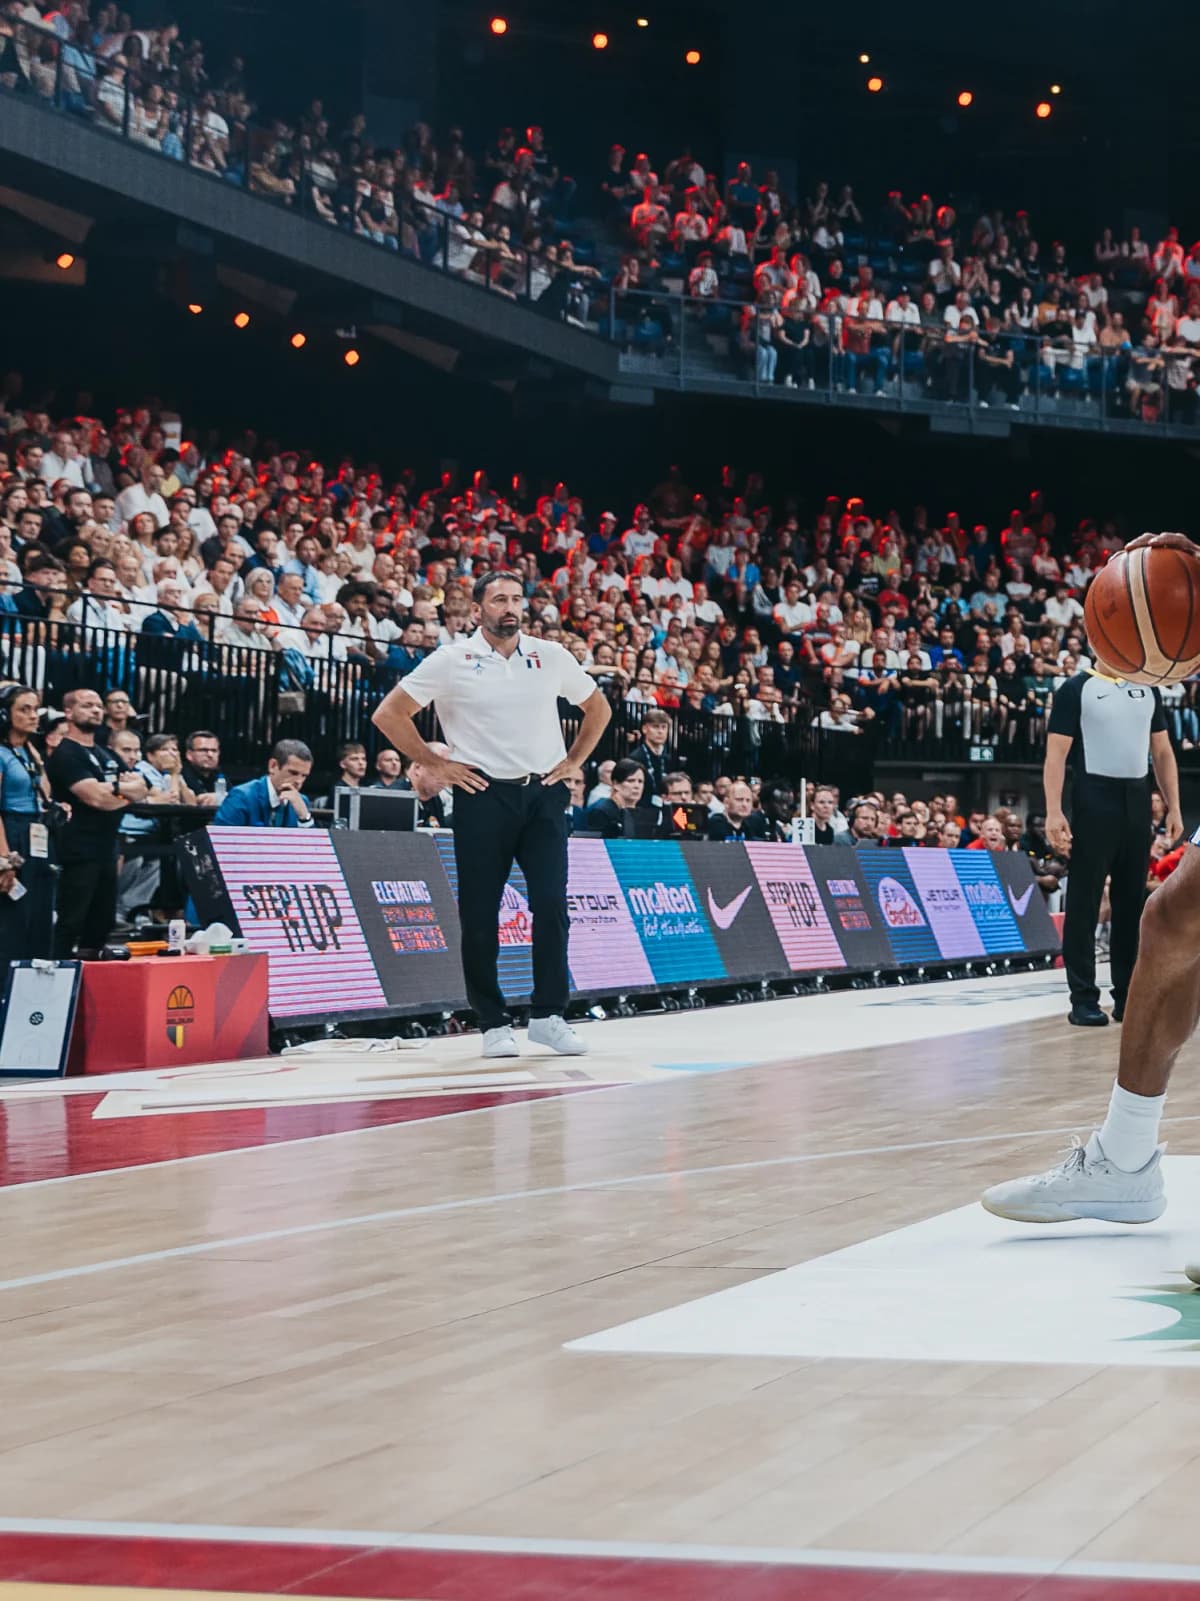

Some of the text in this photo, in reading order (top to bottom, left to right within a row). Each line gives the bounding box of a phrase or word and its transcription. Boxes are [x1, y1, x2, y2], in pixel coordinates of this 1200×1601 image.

[370, 880, 433, 905] ELEVATING
[566, 895, 621, 911] ETOUR
[628, 882, 698, 916] molten
[766, 881, 792, 905] STEP
[242, 884, 292, 919] STEP
[289, 884, 343, 951] UP
